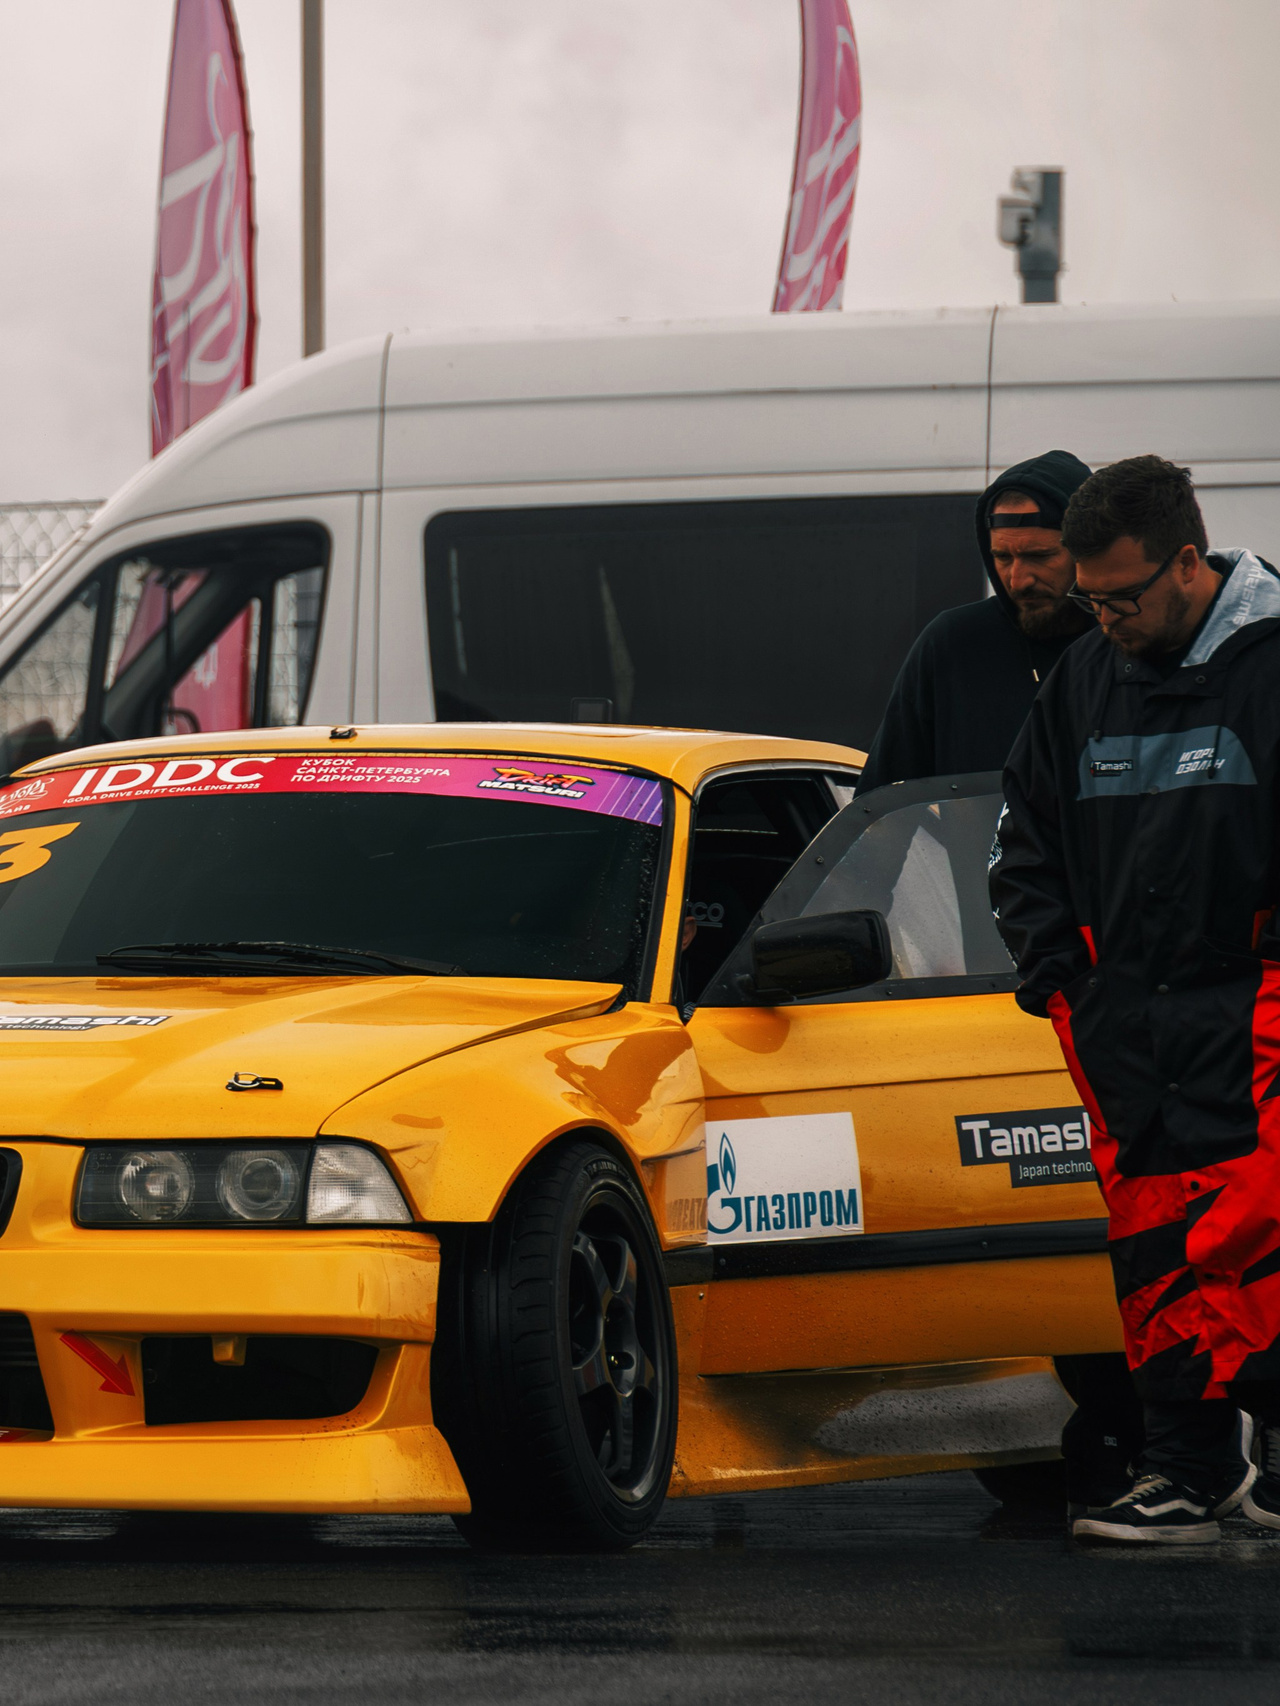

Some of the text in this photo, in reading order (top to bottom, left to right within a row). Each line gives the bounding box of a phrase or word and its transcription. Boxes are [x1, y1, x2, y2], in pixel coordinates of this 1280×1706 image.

[296, 766, 451, 776] САНКТ-ПЕТЕРБУРГА
[301, 758, 357, 766] КУБОК
[1094, 760, 1133, 771] Tamashi
[68, 757, 276, 798] IDDC
[290, 774, 422, 783] ПО ДРИФТУ 2025
[62, 795, 97, 805] IGORA
[100, 791, 133, 800] DRIVE
[135, 787, 167, 796] DRIFT
[168, 784, 233, 794] CHALLENGE
[478, 780, 586, 798] MATSURI
[961, 1112, 1091, 1158] Tamas
[1018, 1160, 1095, 1180] Japan techno
[744, 1188, 859, 1232] ГАЗПРОМ
